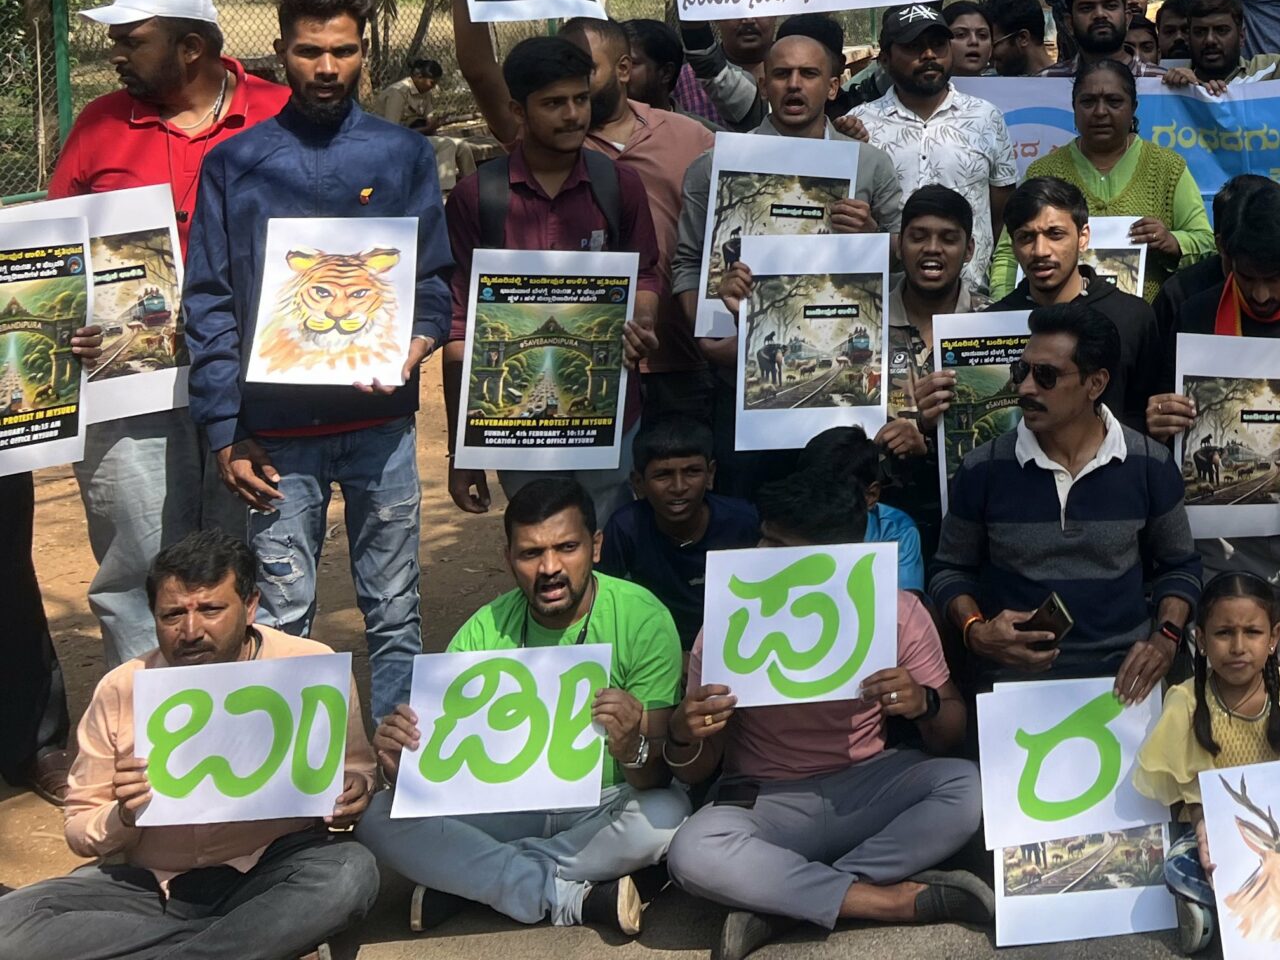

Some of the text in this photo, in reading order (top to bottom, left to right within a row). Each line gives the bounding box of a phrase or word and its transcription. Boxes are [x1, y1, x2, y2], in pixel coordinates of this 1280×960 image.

[3, 405, 76, 425] PROTEST IN MYSURU
[725, 556, 874, 697] ಪು
[148, 687, 346, 797] ಬಂ
[1017, 694, 1123, 819] ರ
